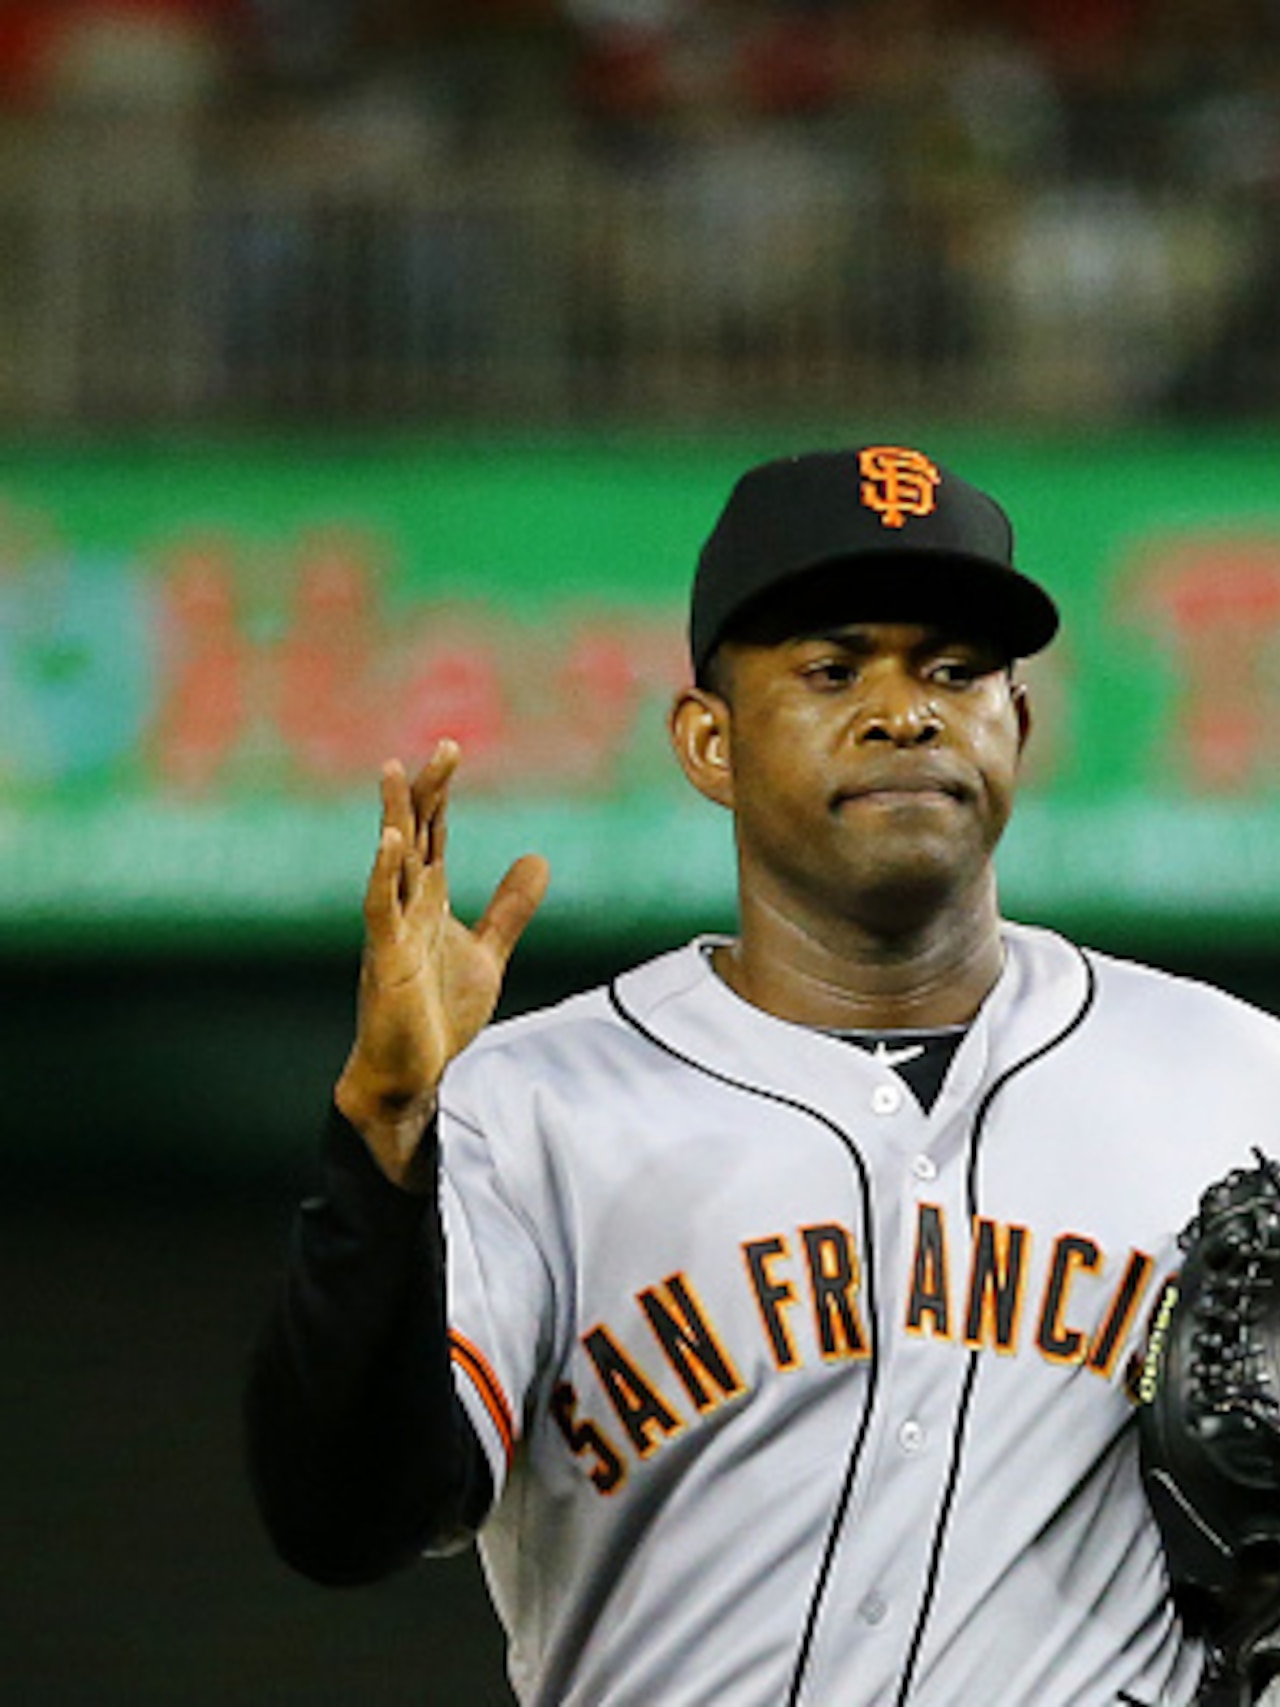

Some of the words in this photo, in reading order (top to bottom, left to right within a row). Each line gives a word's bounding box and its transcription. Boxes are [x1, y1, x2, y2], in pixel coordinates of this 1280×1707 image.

[857, 445, 942, 528] SF
[551, 1270, 749, 1497] SAN
[741, 1202, 1178, 1406] FRANCI
